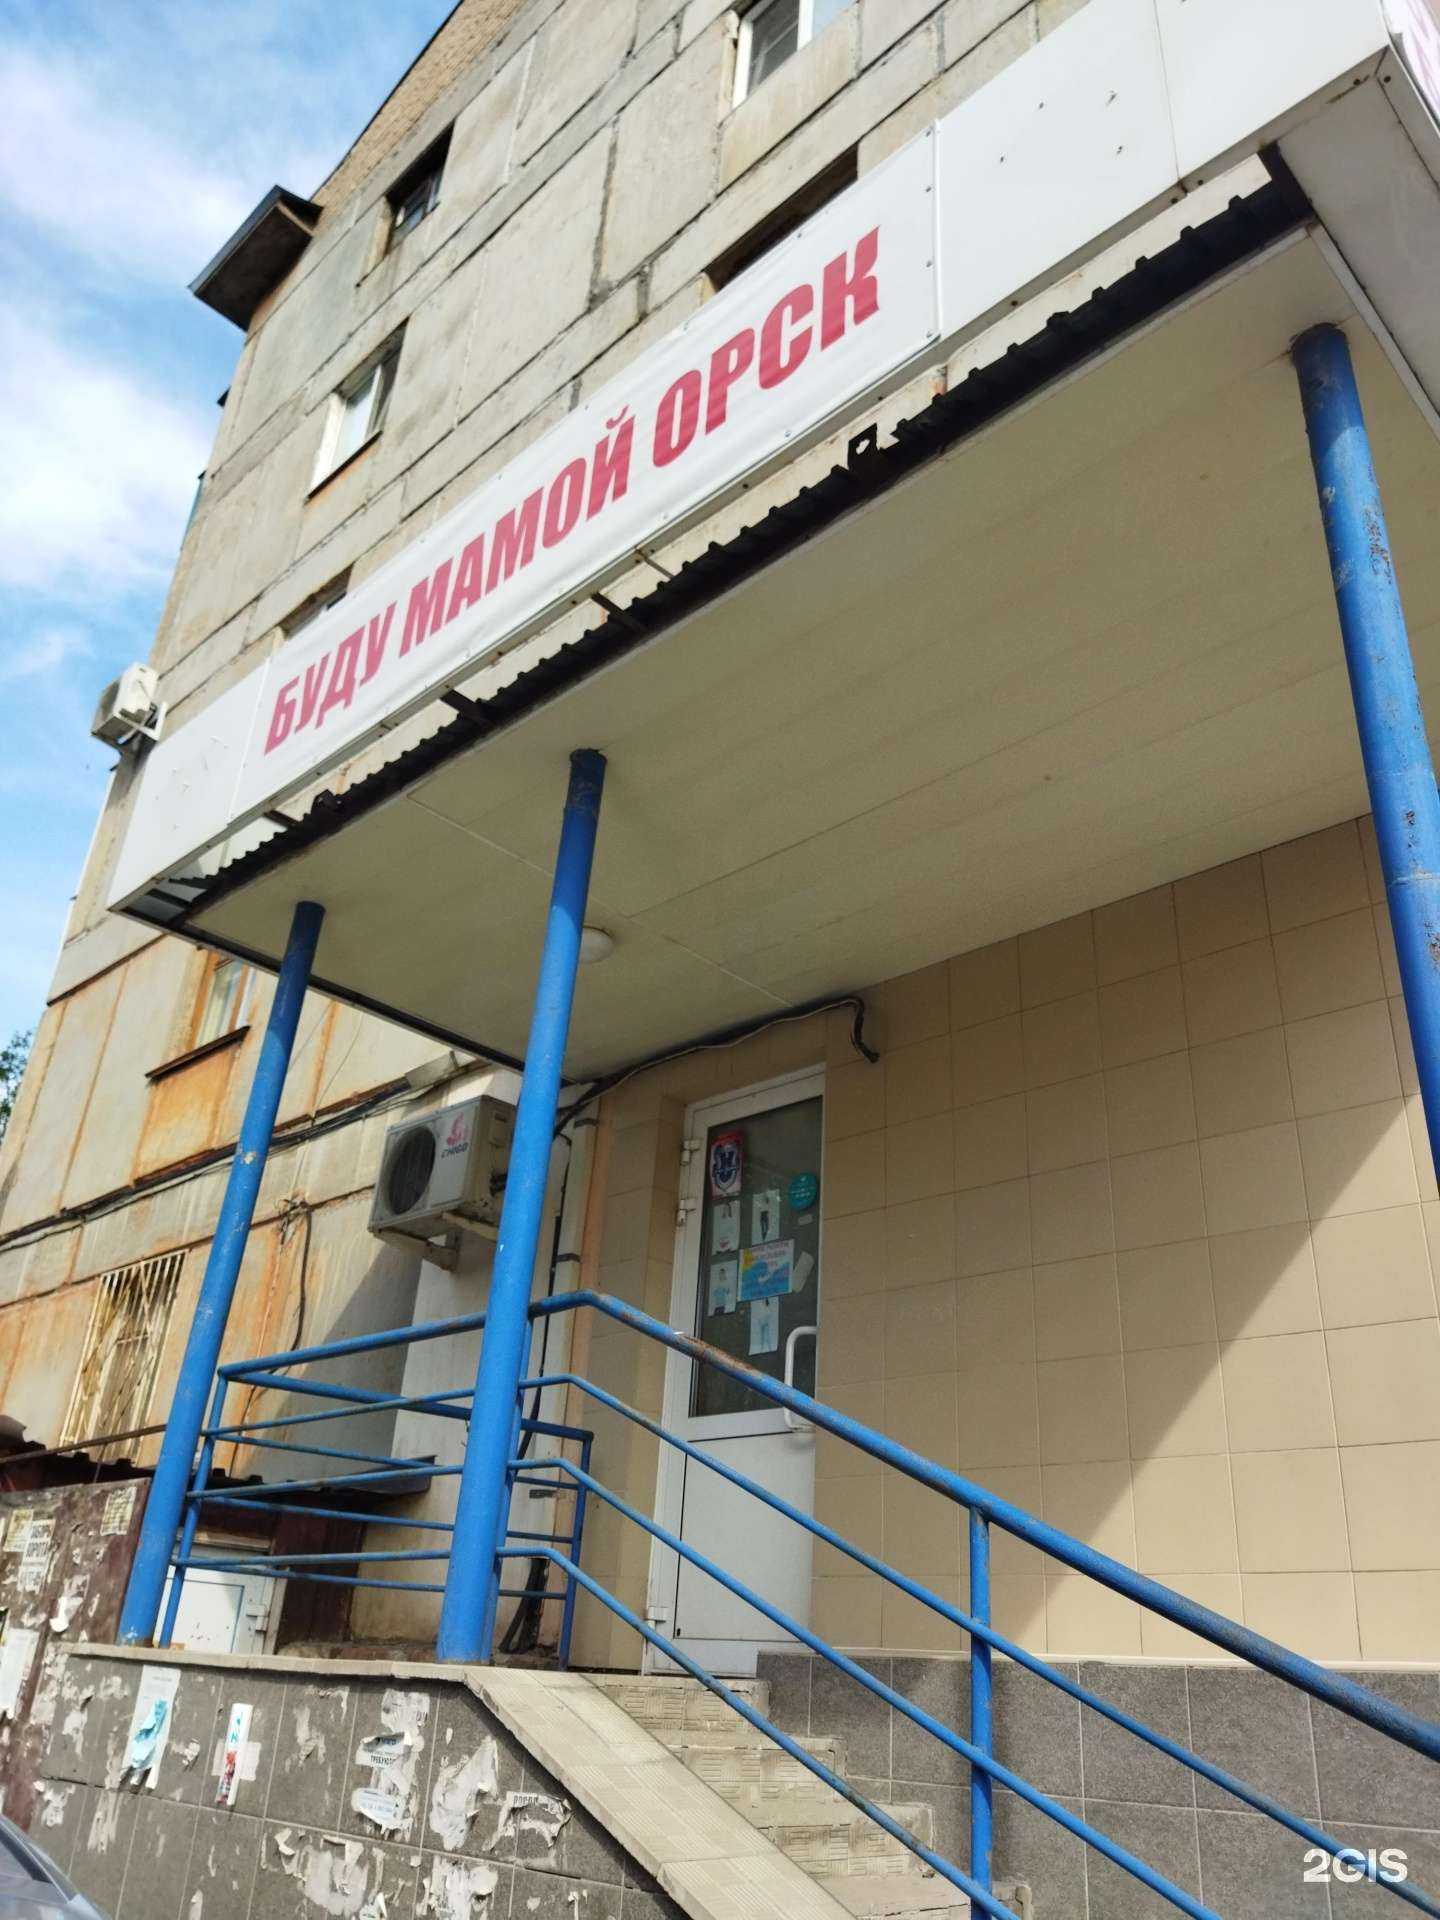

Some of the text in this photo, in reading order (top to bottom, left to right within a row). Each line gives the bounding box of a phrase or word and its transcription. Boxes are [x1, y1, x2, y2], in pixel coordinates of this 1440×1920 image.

[264, 227, 880, 756] БУДУ МАМОЙ ОРСК
